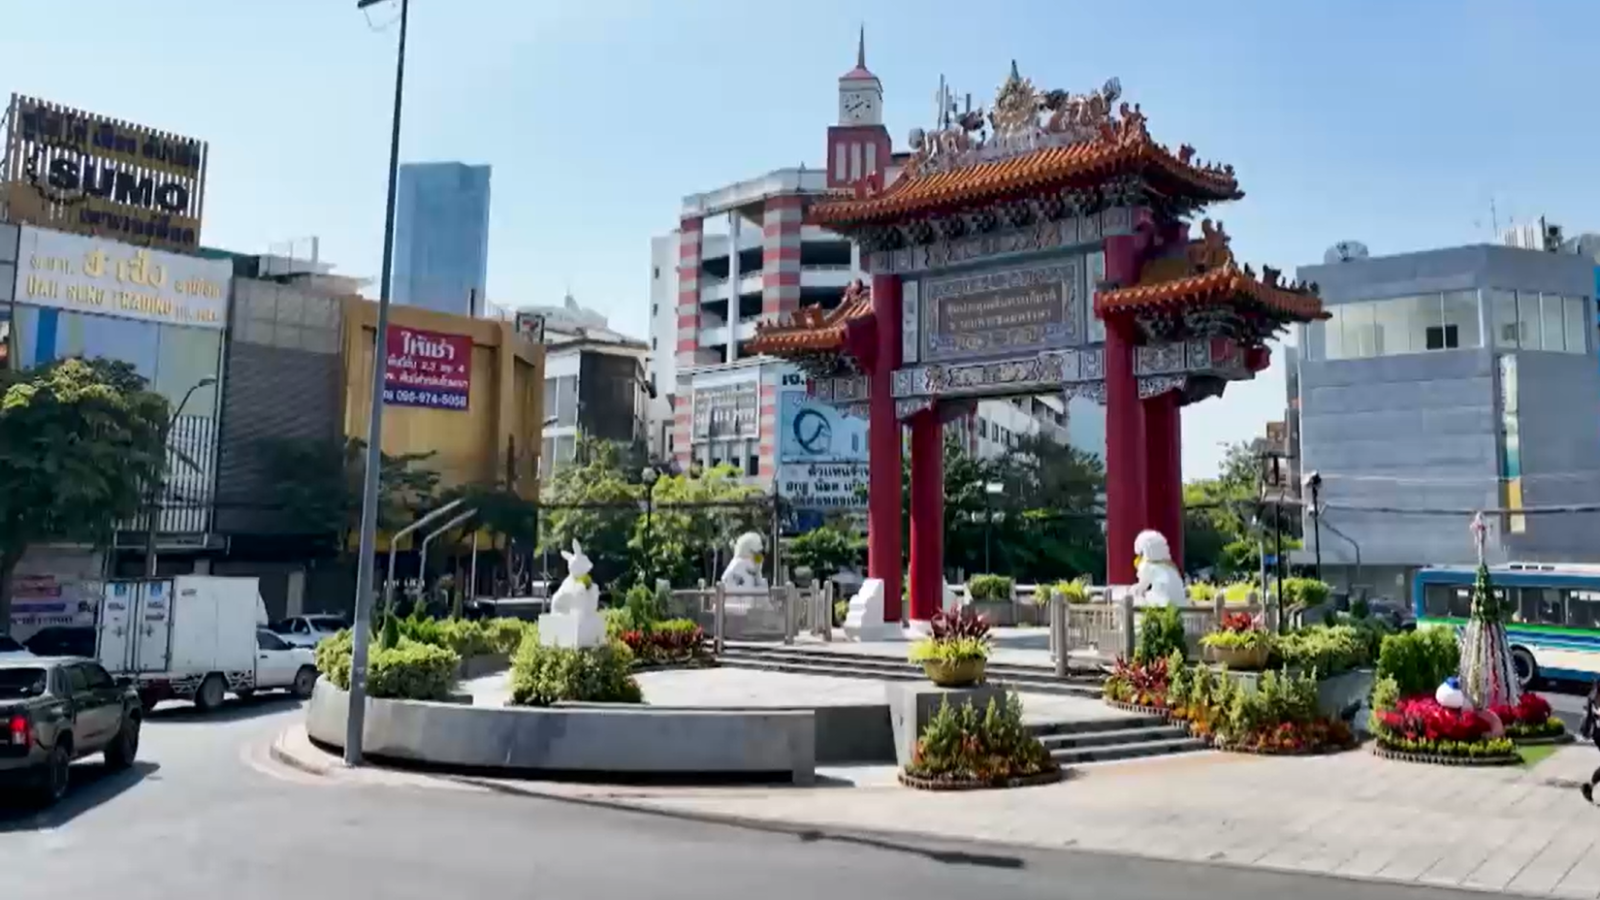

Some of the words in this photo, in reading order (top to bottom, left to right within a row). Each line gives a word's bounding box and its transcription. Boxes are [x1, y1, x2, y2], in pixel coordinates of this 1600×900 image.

[48, 157, 190, 211] SUMO
[401, 331, 454, 360] ให้เช่า
